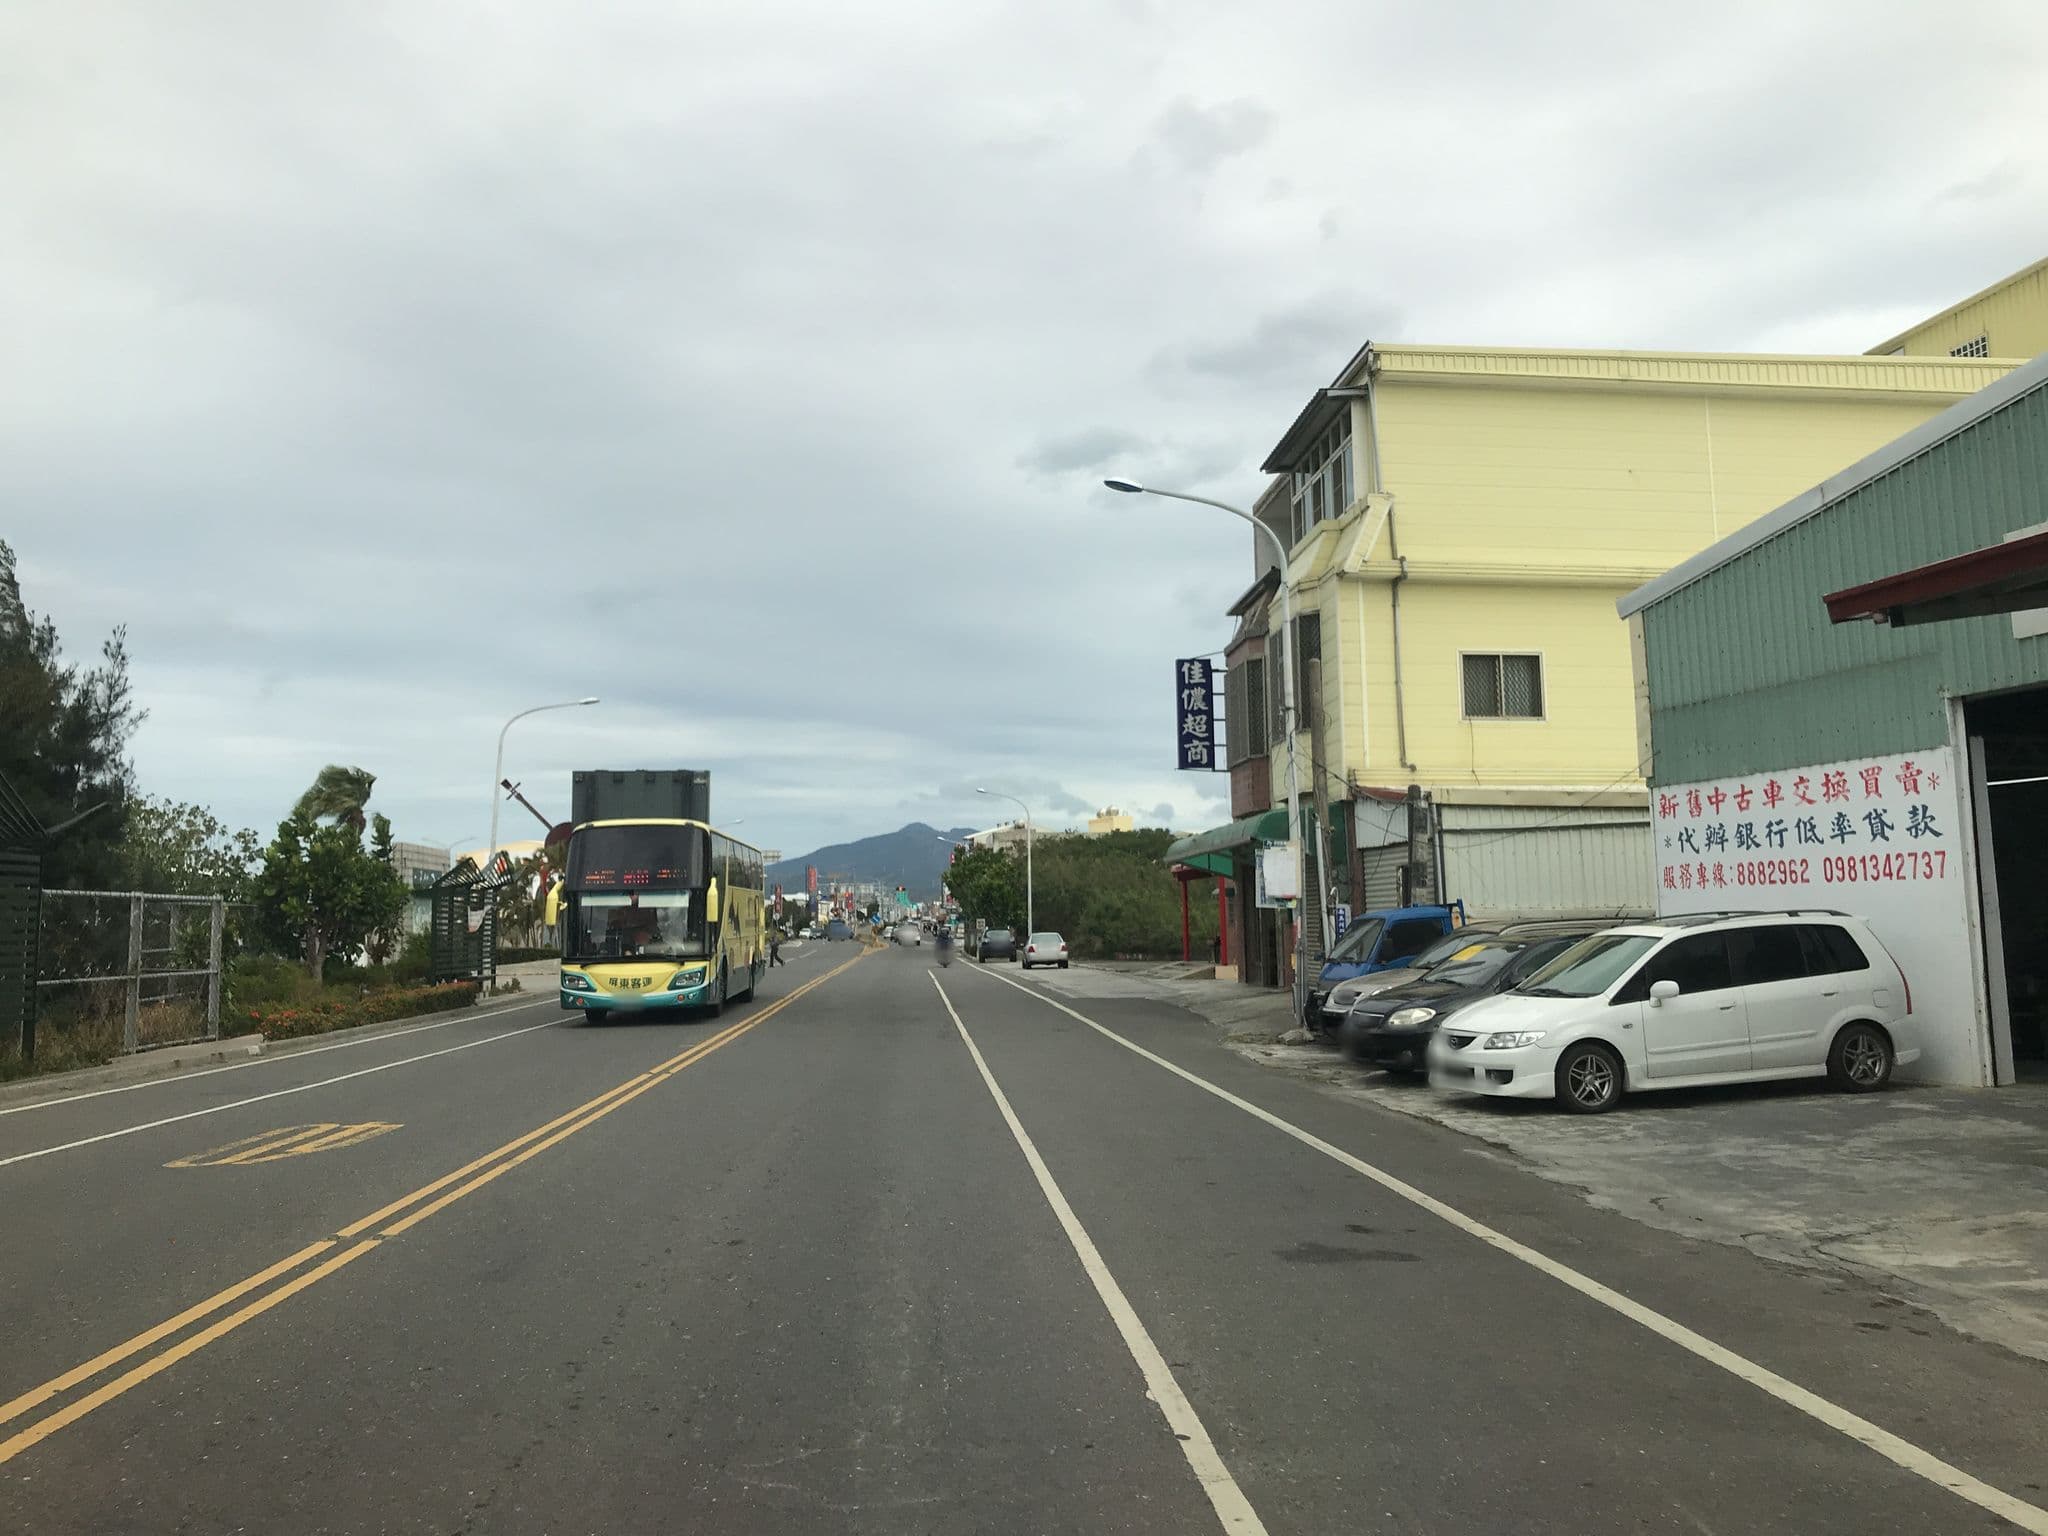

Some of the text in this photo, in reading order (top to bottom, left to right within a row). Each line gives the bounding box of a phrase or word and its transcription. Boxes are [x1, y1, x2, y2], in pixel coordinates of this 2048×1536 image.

[1181, 661, 1210, 764] 佳儂超商
[1658, 761, 1923, 819] 新舊中古車交換買賣
[1823, 850, 1946, 883] 0981342737
